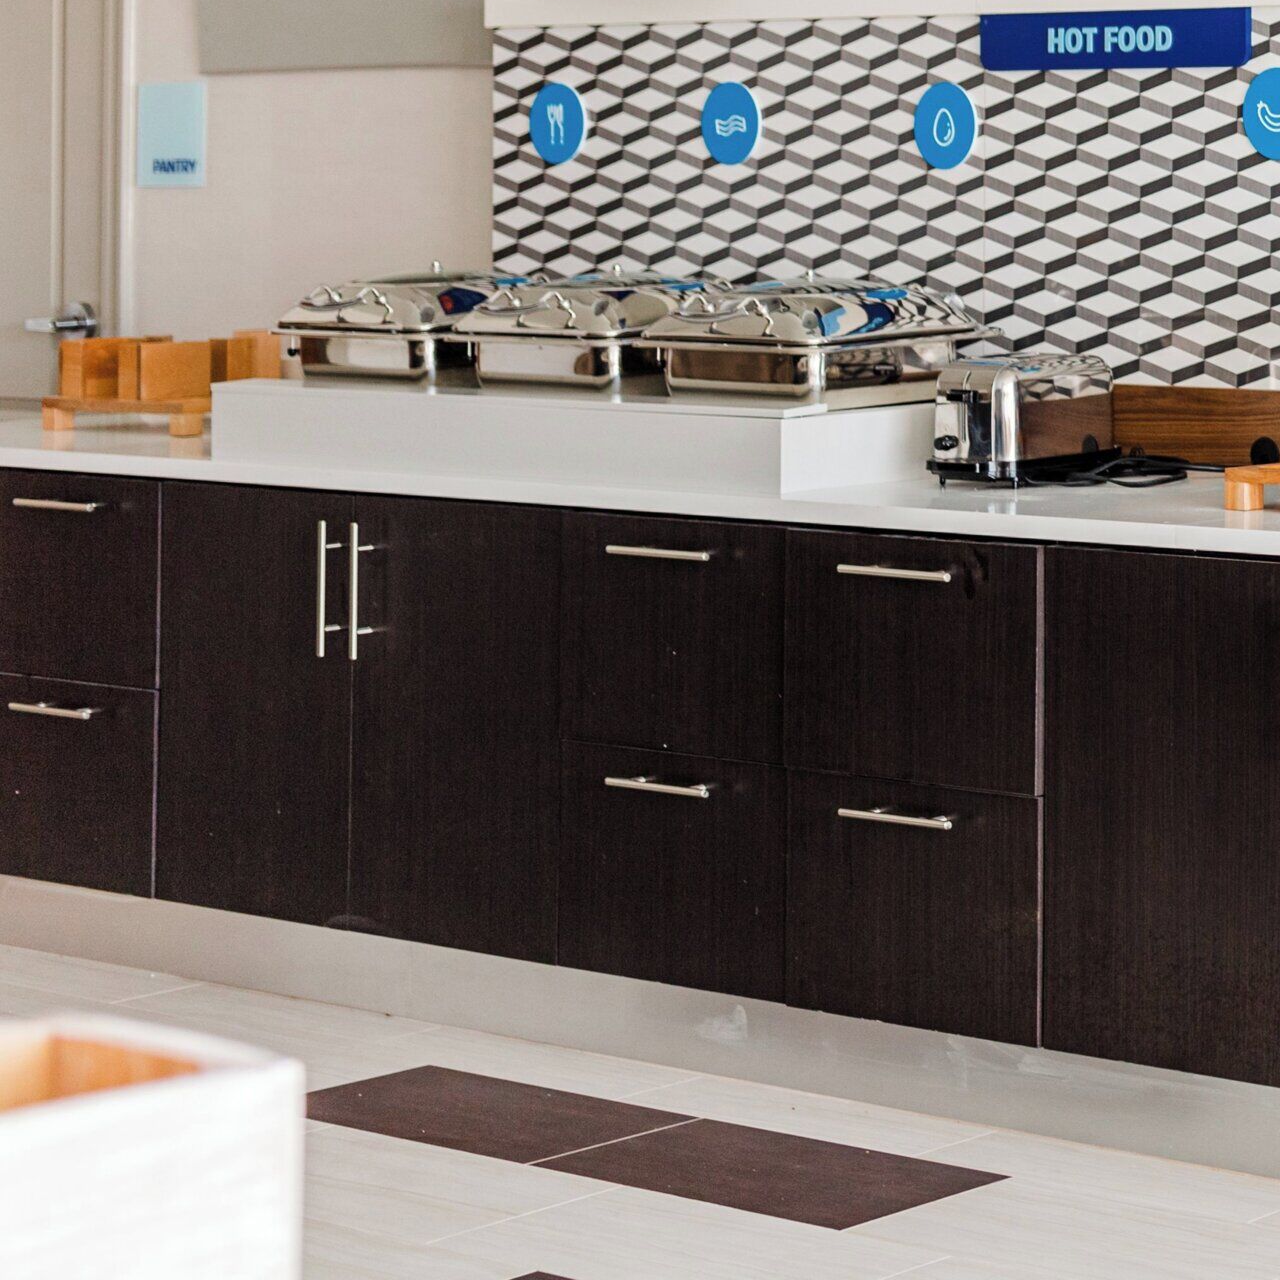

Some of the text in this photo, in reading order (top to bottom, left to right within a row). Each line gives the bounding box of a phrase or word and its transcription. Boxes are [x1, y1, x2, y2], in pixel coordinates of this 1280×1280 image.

[1048, 25, 1173, 53] HOT FOOD
[152, 158, 197, 175] PANTRY
